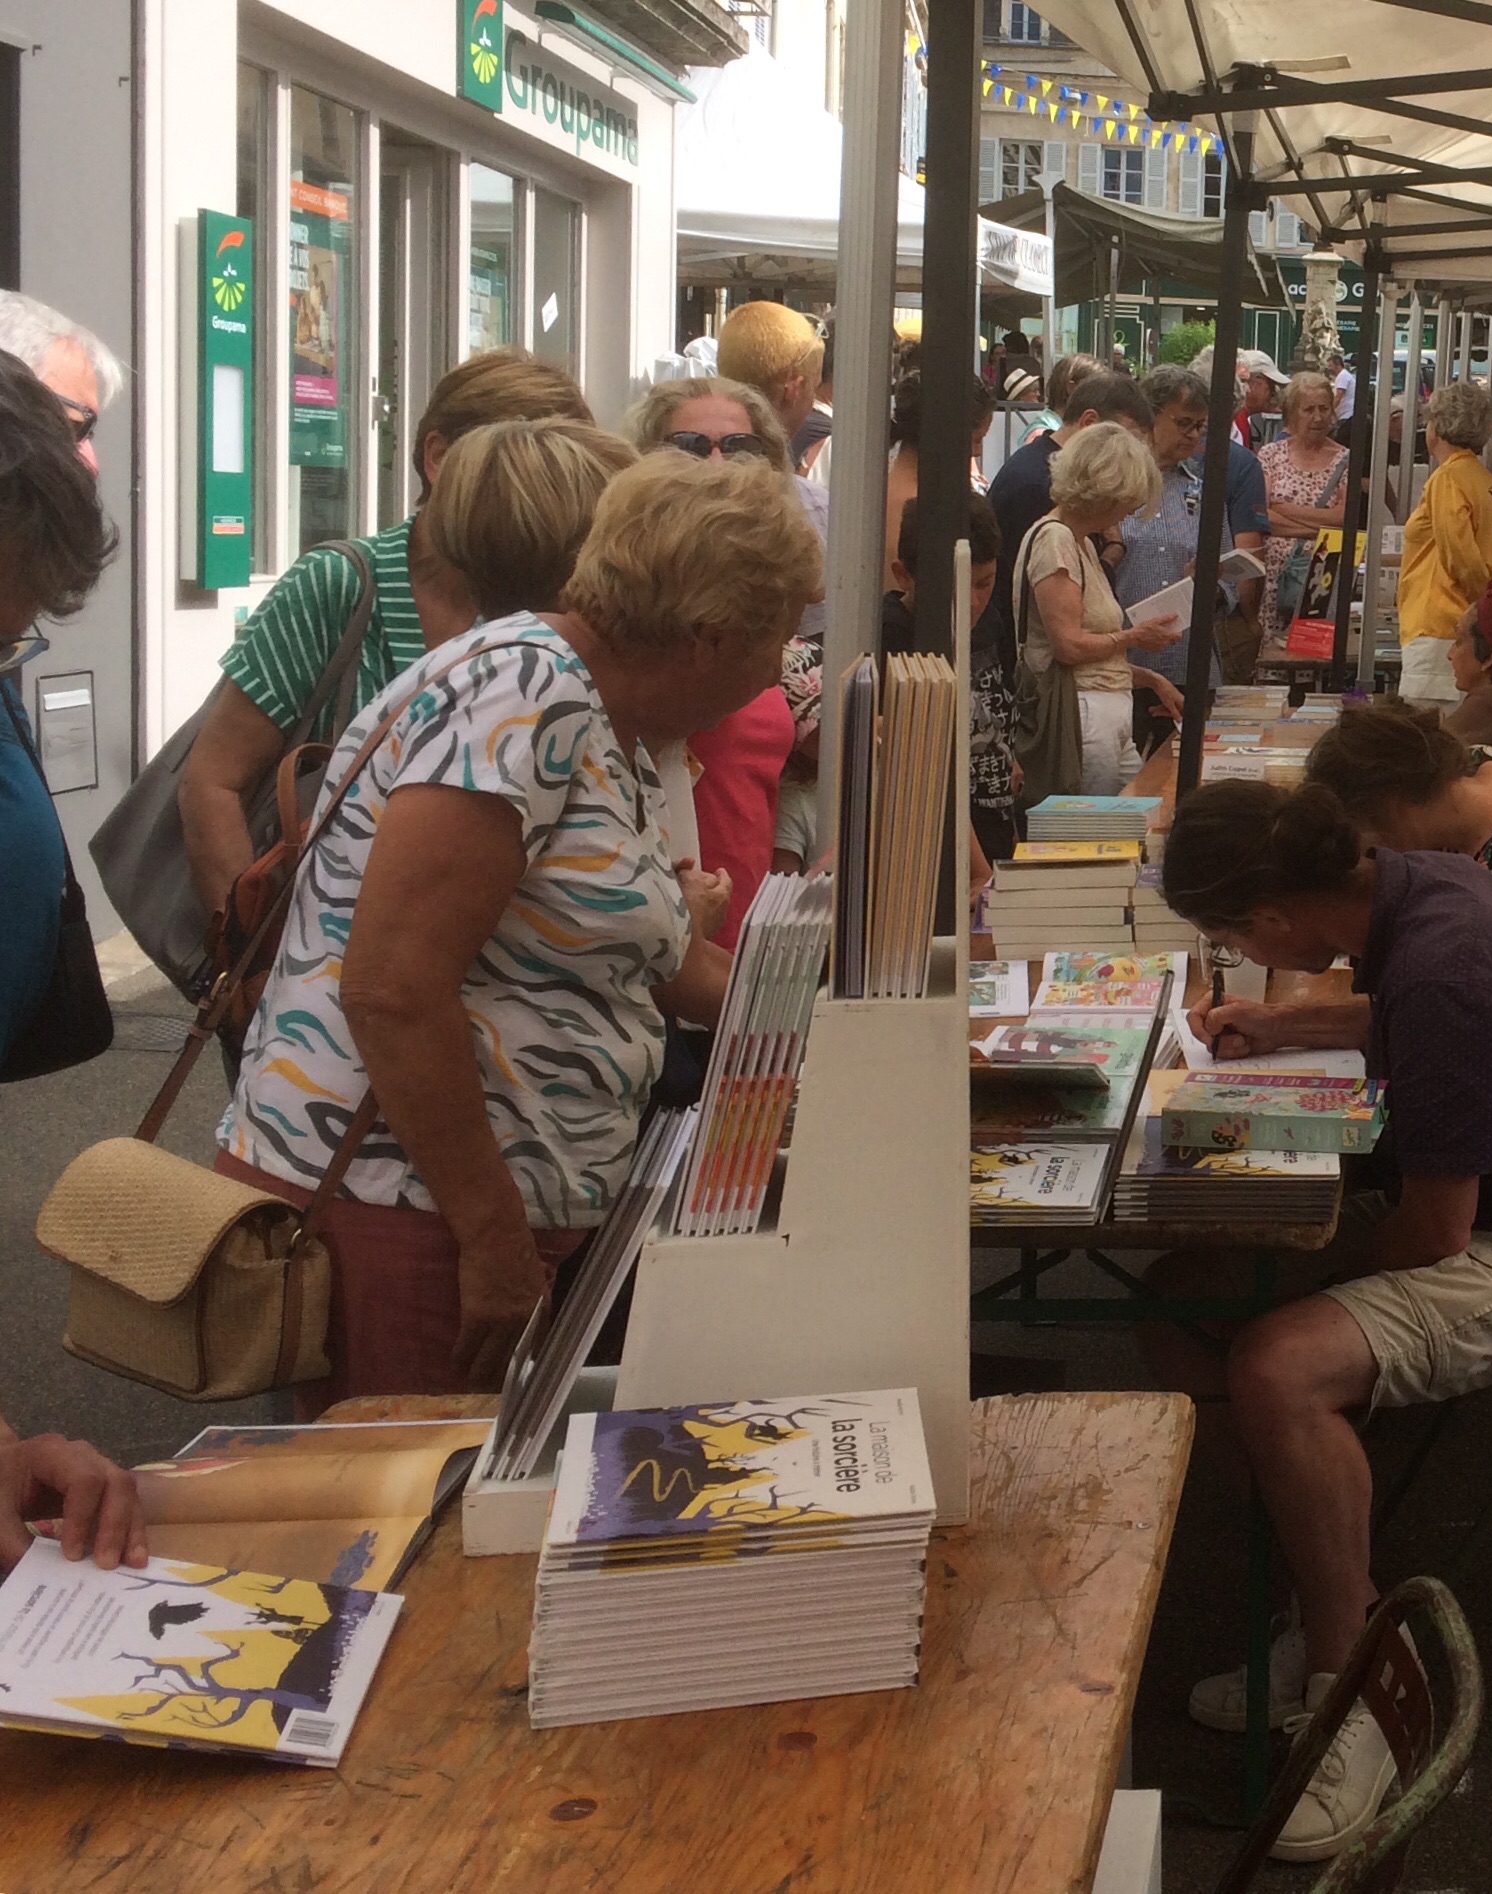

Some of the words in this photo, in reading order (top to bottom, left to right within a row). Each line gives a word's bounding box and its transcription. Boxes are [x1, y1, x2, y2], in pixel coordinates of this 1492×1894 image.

[504, 29, 638, 167] Groupama
[212, 315, 247, 334] Groupama
[831, 1418, 863, 1433] la
[869, 1420, 891, 1434] La
[870, 1435, 894, 1469] maison
[832, 1435, 868, 1493] sorcière
[875, 1470, 899, 1484] de
